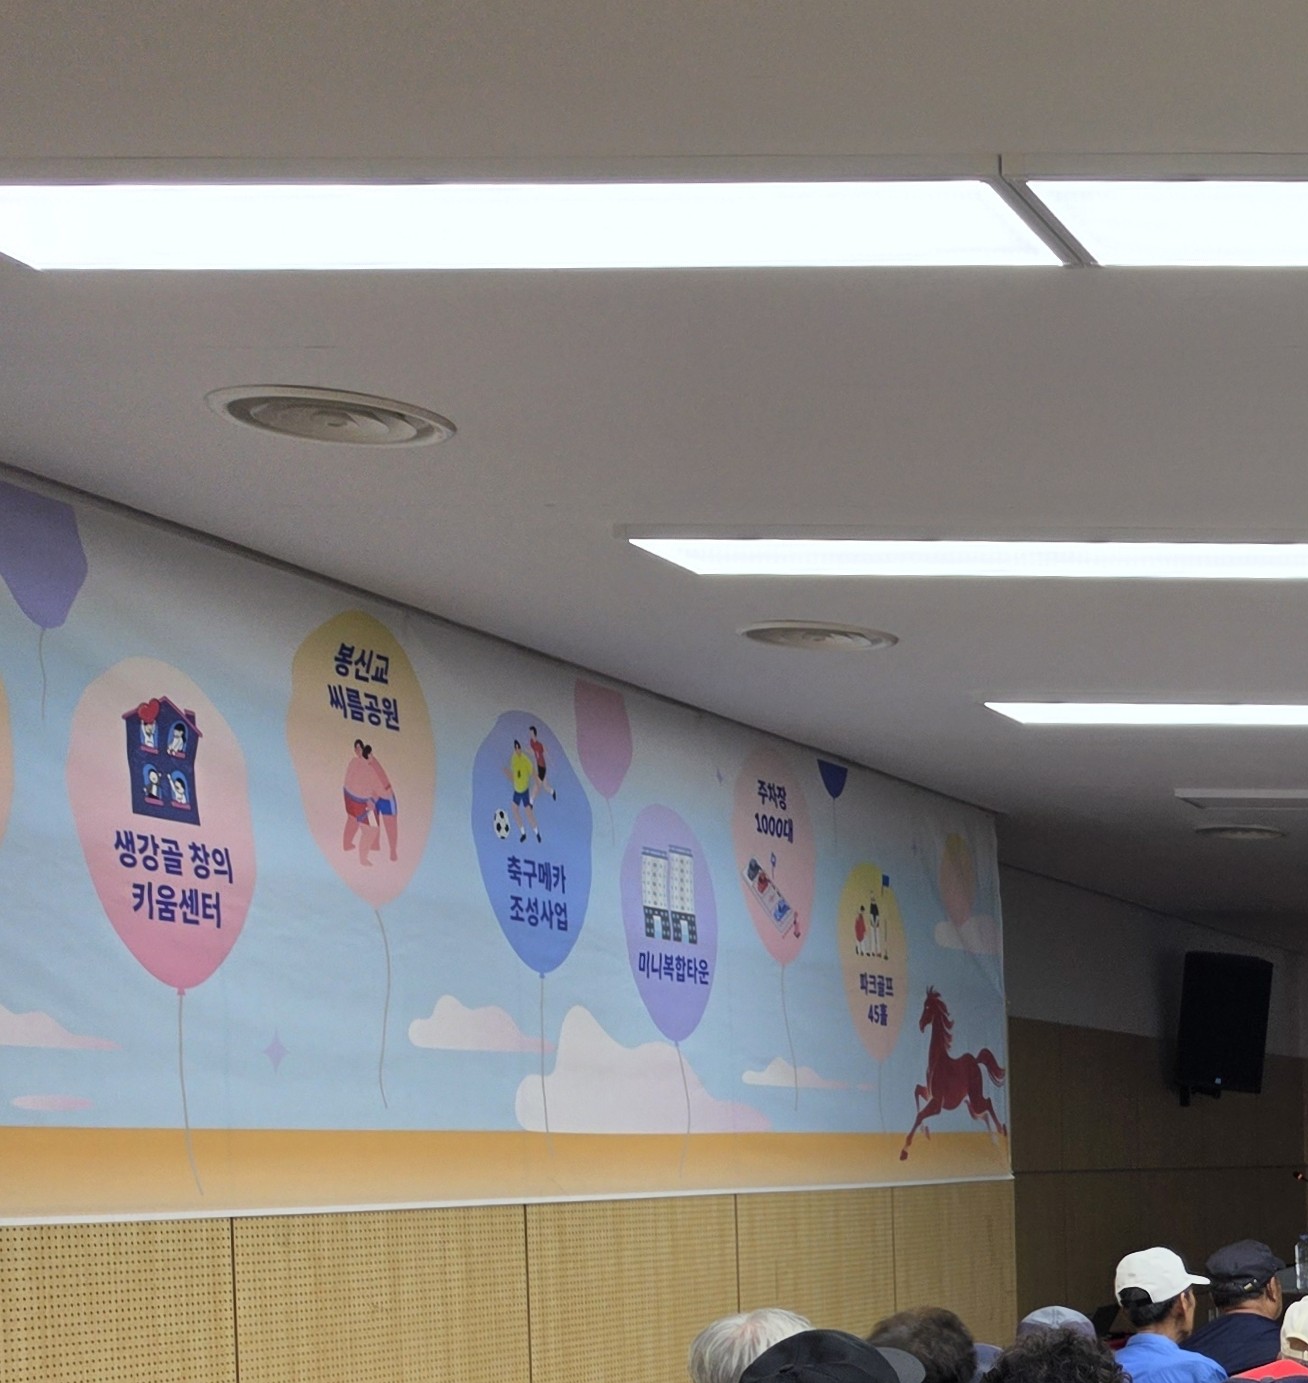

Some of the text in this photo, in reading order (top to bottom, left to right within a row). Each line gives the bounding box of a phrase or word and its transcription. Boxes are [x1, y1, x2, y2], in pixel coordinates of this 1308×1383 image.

[334, 642, 389, 684] 봉신교
[327, 684, 399, 731] 씨름공원
[757, 779, 787, 810] 주차장
[755, 813, 793, 844] 1000대
[114, 830, 233, 884] 생강골 창의
[507, 855, 566, 894] 축구메카
[132, 881, 221, 928] 키움센터
[510, 895, 568, 931] 조성사업
[638, 951, 709, 985] 미니복합타운
[860, 972, 894, 997] 파크골프
[868, 1003, 888, 1026] 45홀
